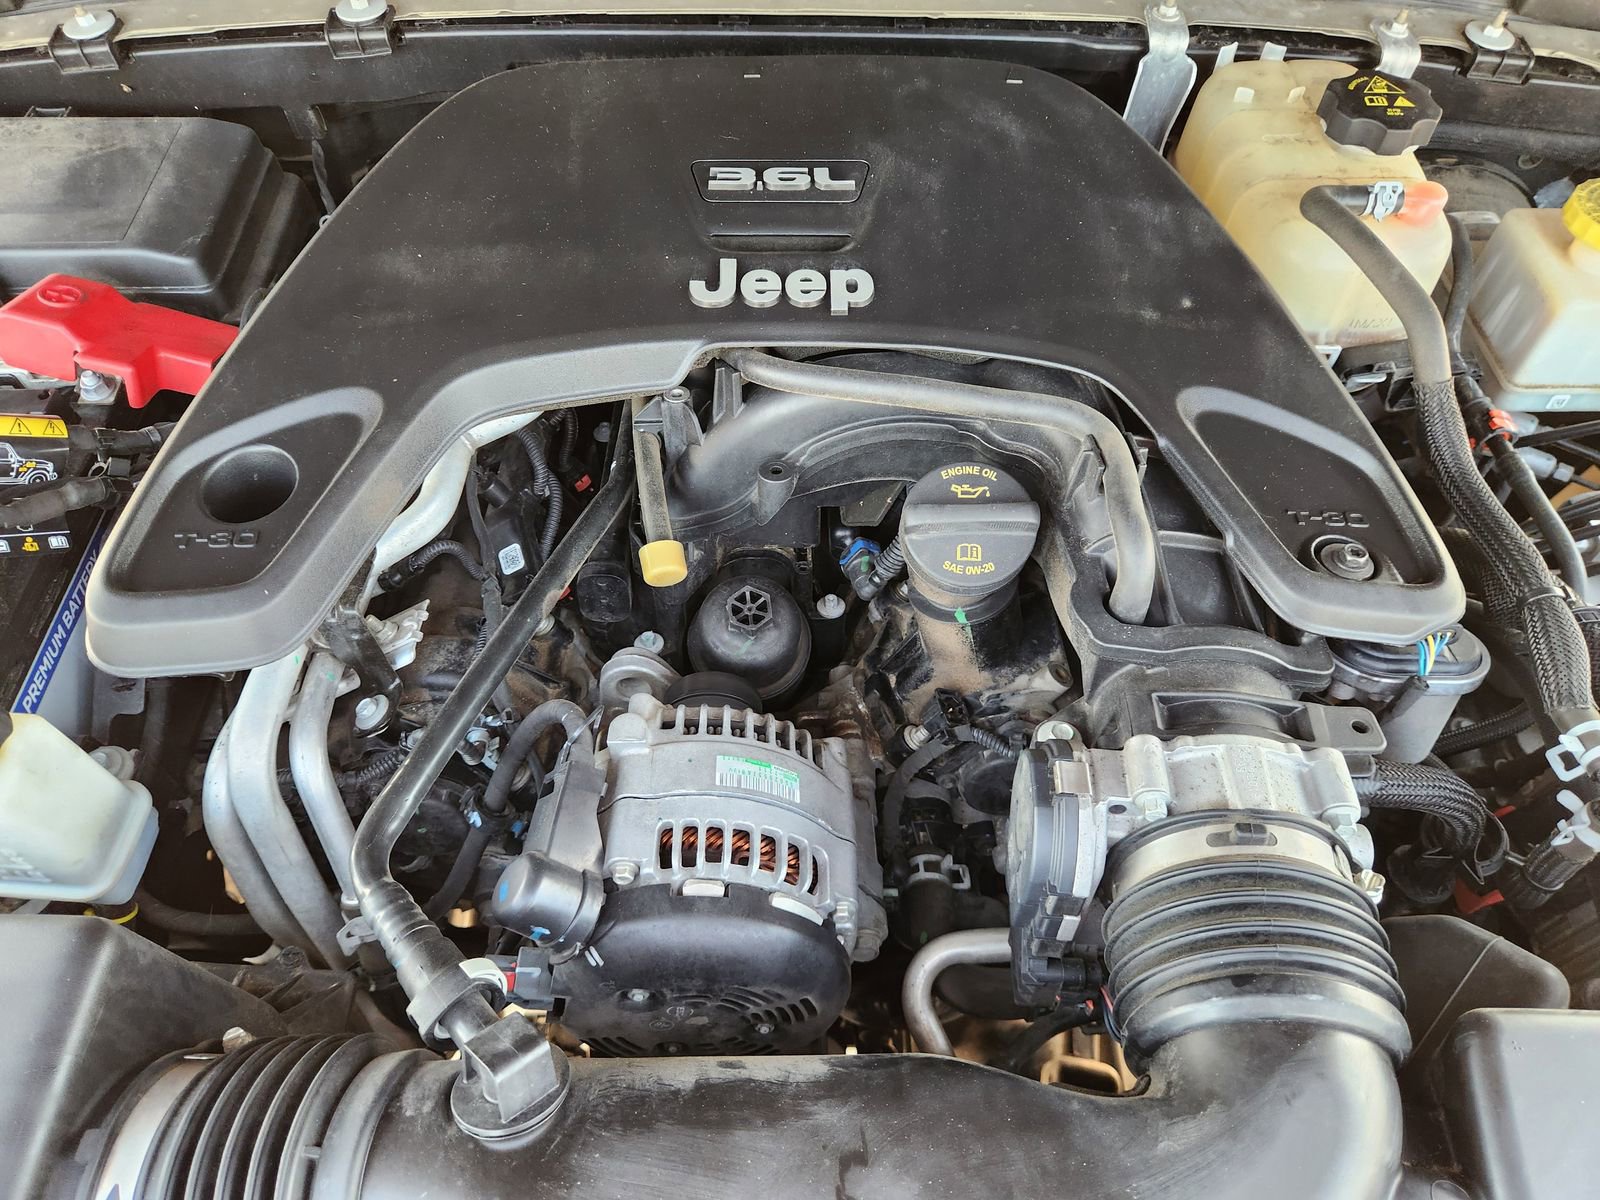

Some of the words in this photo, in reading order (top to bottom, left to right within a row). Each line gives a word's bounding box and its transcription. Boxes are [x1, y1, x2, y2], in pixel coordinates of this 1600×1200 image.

[707, 166, 856, 191] 3.6L
[688, 257, 875, 317] Jeep
[940, 465, 981, 480] ENGINE
[981, 468, 998, 481] OIL
[1285, 510, 1370, 528] T-30
[173, 531, 258, 549] T-30
[942, 560, 964, 575] SAE
[965, 562, 996, 576] 0W-20
[22, 623, 67, 713] PREMIUM
[62, 549, 98, 631] BATTERY
